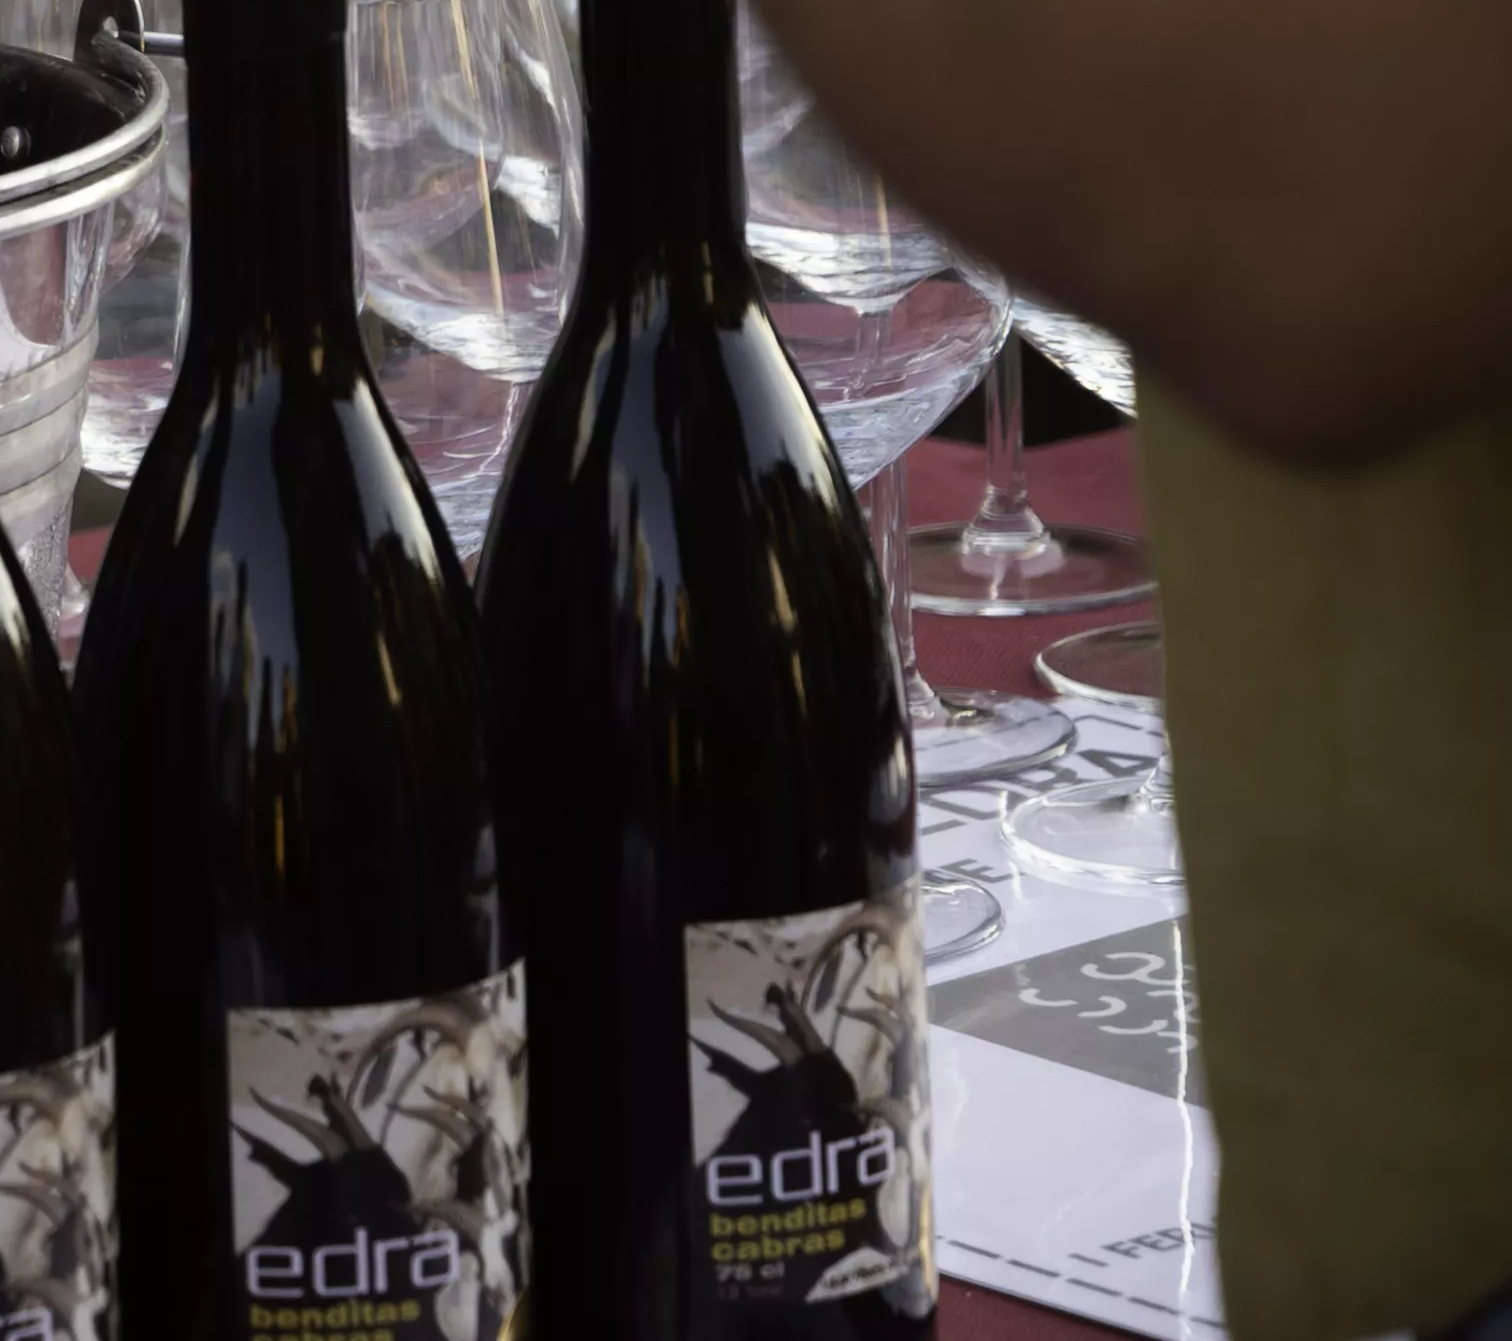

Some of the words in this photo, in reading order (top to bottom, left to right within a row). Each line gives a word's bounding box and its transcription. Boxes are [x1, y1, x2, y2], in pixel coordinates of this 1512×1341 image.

[705, 1127, 895, 1207] edra
[709, 1196, 866, 1237] benditas
[244, 1225, 460, 1299] edra
[710, 1229, 847, 1262] cabras
[248, 1298, 421, 1330] benditas
